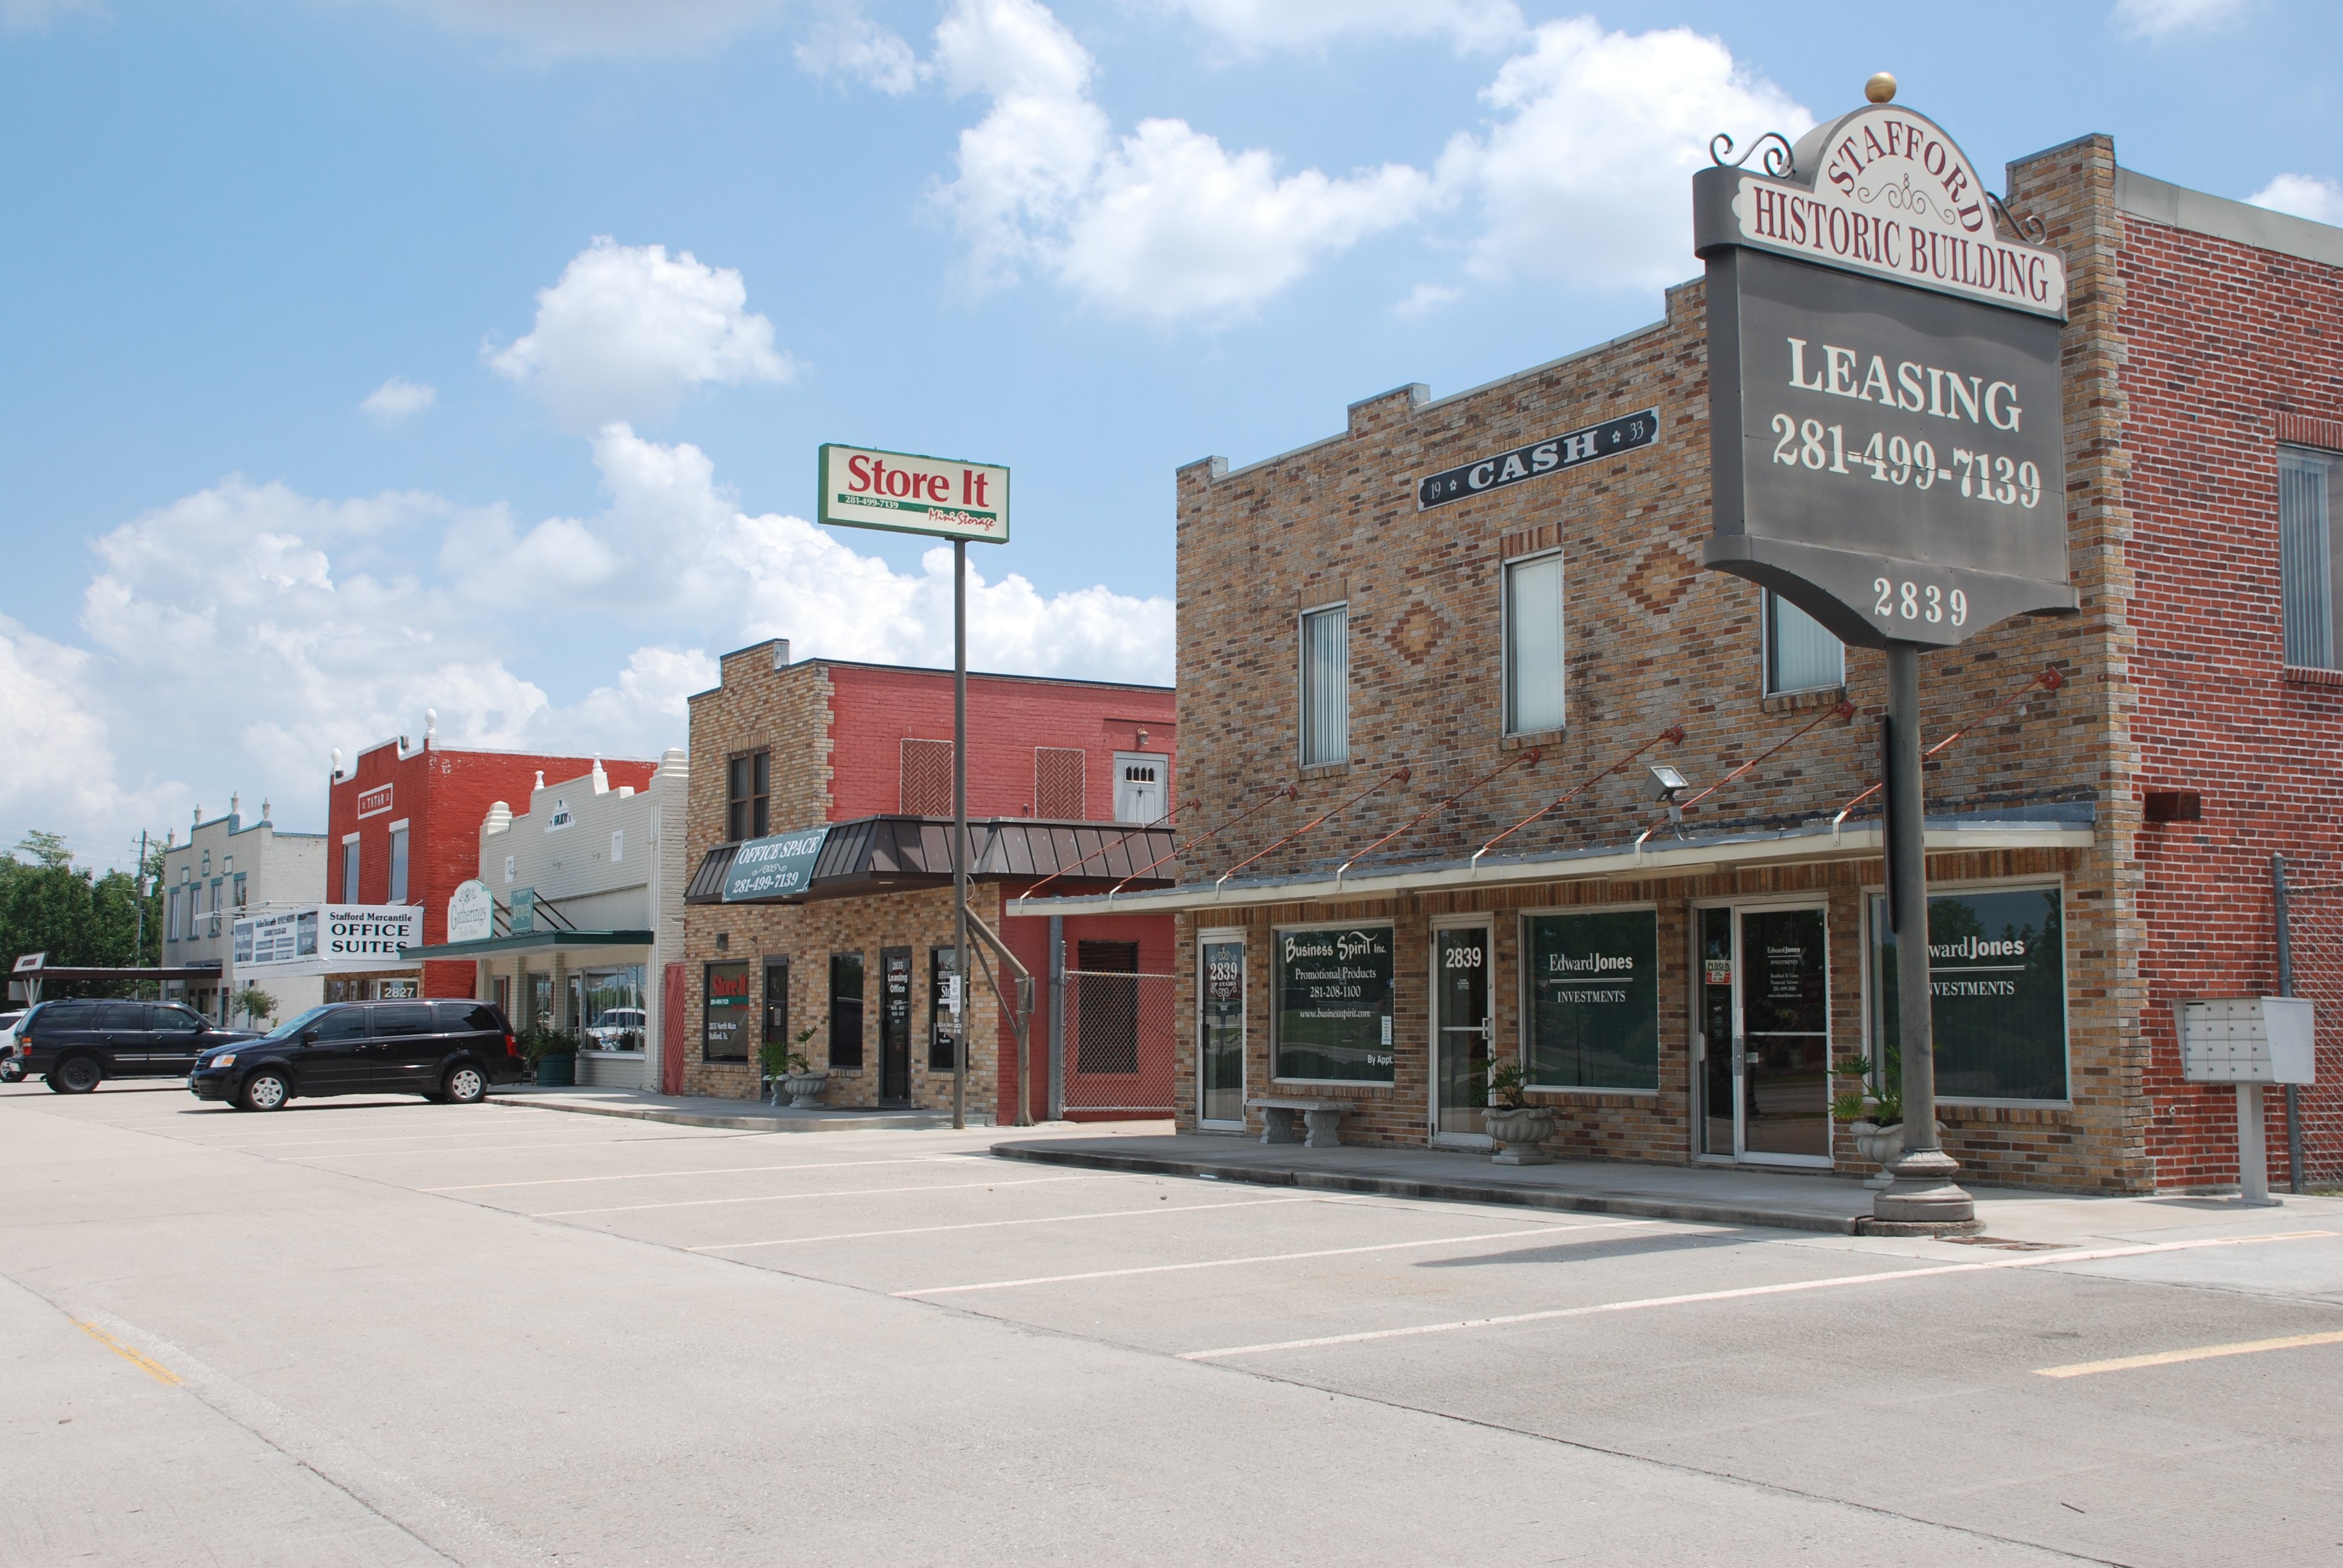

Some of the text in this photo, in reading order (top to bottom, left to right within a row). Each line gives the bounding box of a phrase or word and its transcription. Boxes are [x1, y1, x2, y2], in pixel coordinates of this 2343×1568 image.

[1827, 120, 1984, 232] STAFFORD
[1754, 186, 2049, 304] HISTORIC BUILDING
[1787, 337, 2023, 433] LEASING
[1430, 420, 1644, 499] 19 CASH 33
[1771, 413, 2041, 509] 281-499-7139
[848, 455, 989, 508] Store It
[845, 495, 899, 509] 281-499-7139
[928, 508, 995, 531] Mini Storage
[1873, 577, 1968, 627] 2839
[367, 793, 384, 808] TATAR
[738, 836, 821, 864] OFFICE SPACE
[732, 872, 799, 893] 281-499-7139
[330, 912, 412, 921] Stafford Mercantile
[451, 903, 486, 930] Gatherings
[331, 923, 410, 936] OFFICE
[331, 940, 407, 953] SUITES
[1286, 937, 1333, 962] Business
[1374, 944, 1387, 953] Inc.
[1928, 936, 2025, 959] ward Jones
[1446, 947, 1481, 968] 2839
[1210, 962, 1237, 980] 2839
[1295, 967, 1377, 980] Promotional Products
[1708, 963, 1729, 972] CLOSED
[712, 975, 737, 996] Store
[888, 973, 908, 983] Leasing
[384, 987, 415, 998] 2827
[890, 984, 905, 993] Office
[1310, 985, 1361, 998] 281-208-1100
[1558, 990, 1625, 1002] INVESTMENTS
[1929, 981, 2014, 996] VESTMENTS
[1300, 1008, 1371, 1020] www.businessspirit.com
[1368, 1055, 1393, 1066] By Appt.
